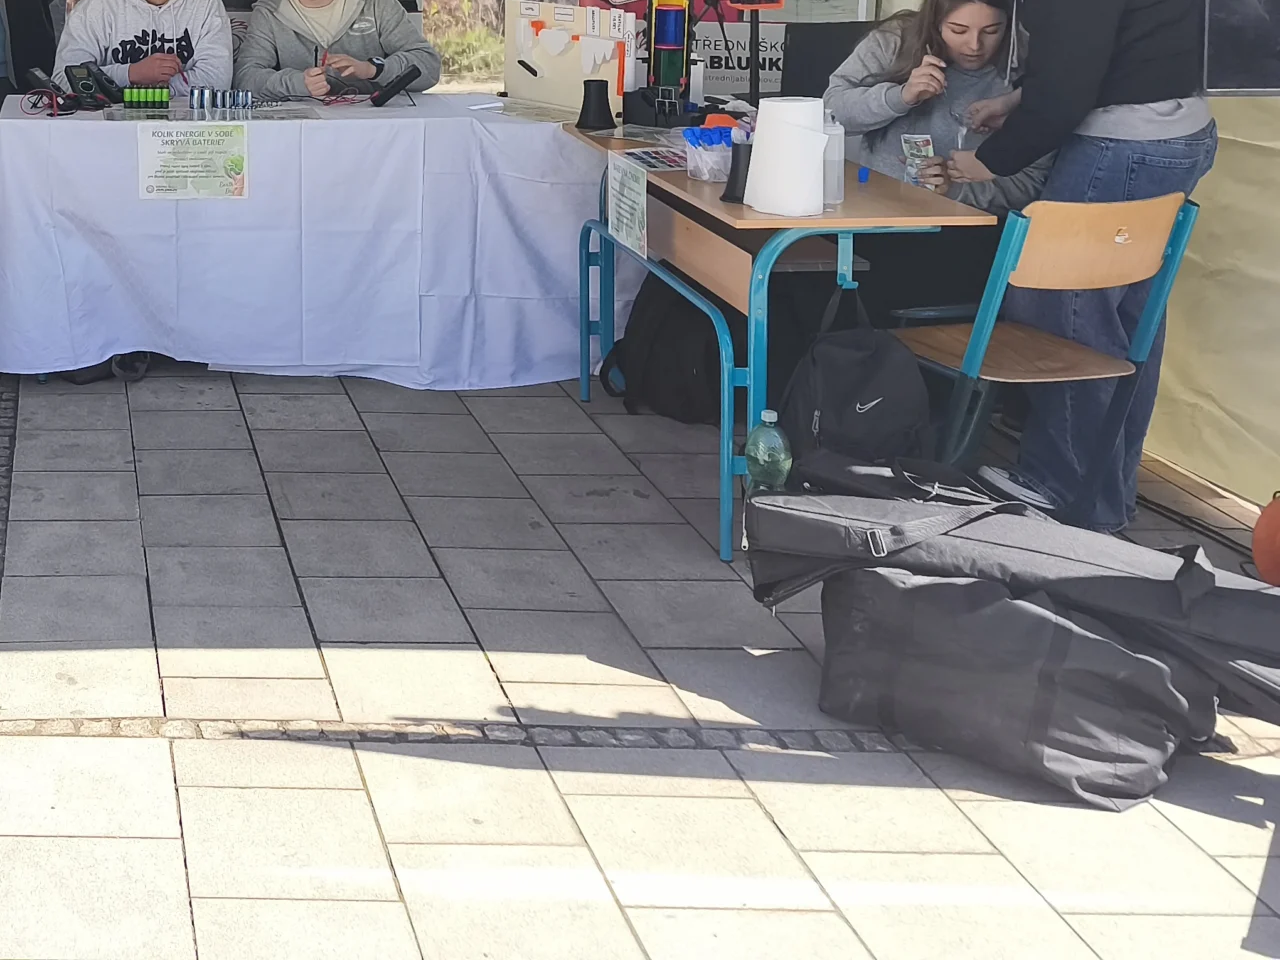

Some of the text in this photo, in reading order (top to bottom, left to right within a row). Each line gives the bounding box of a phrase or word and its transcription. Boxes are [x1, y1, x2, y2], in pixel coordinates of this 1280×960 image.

[694, 35, 747, 51] TŘEDN
[151, 130, 174, 138] KOLIK
[175, 130, 206, 138] ENERGIE
[208, 130, 213, 138] V
[192, 138, 226, 146] BATERIE?
